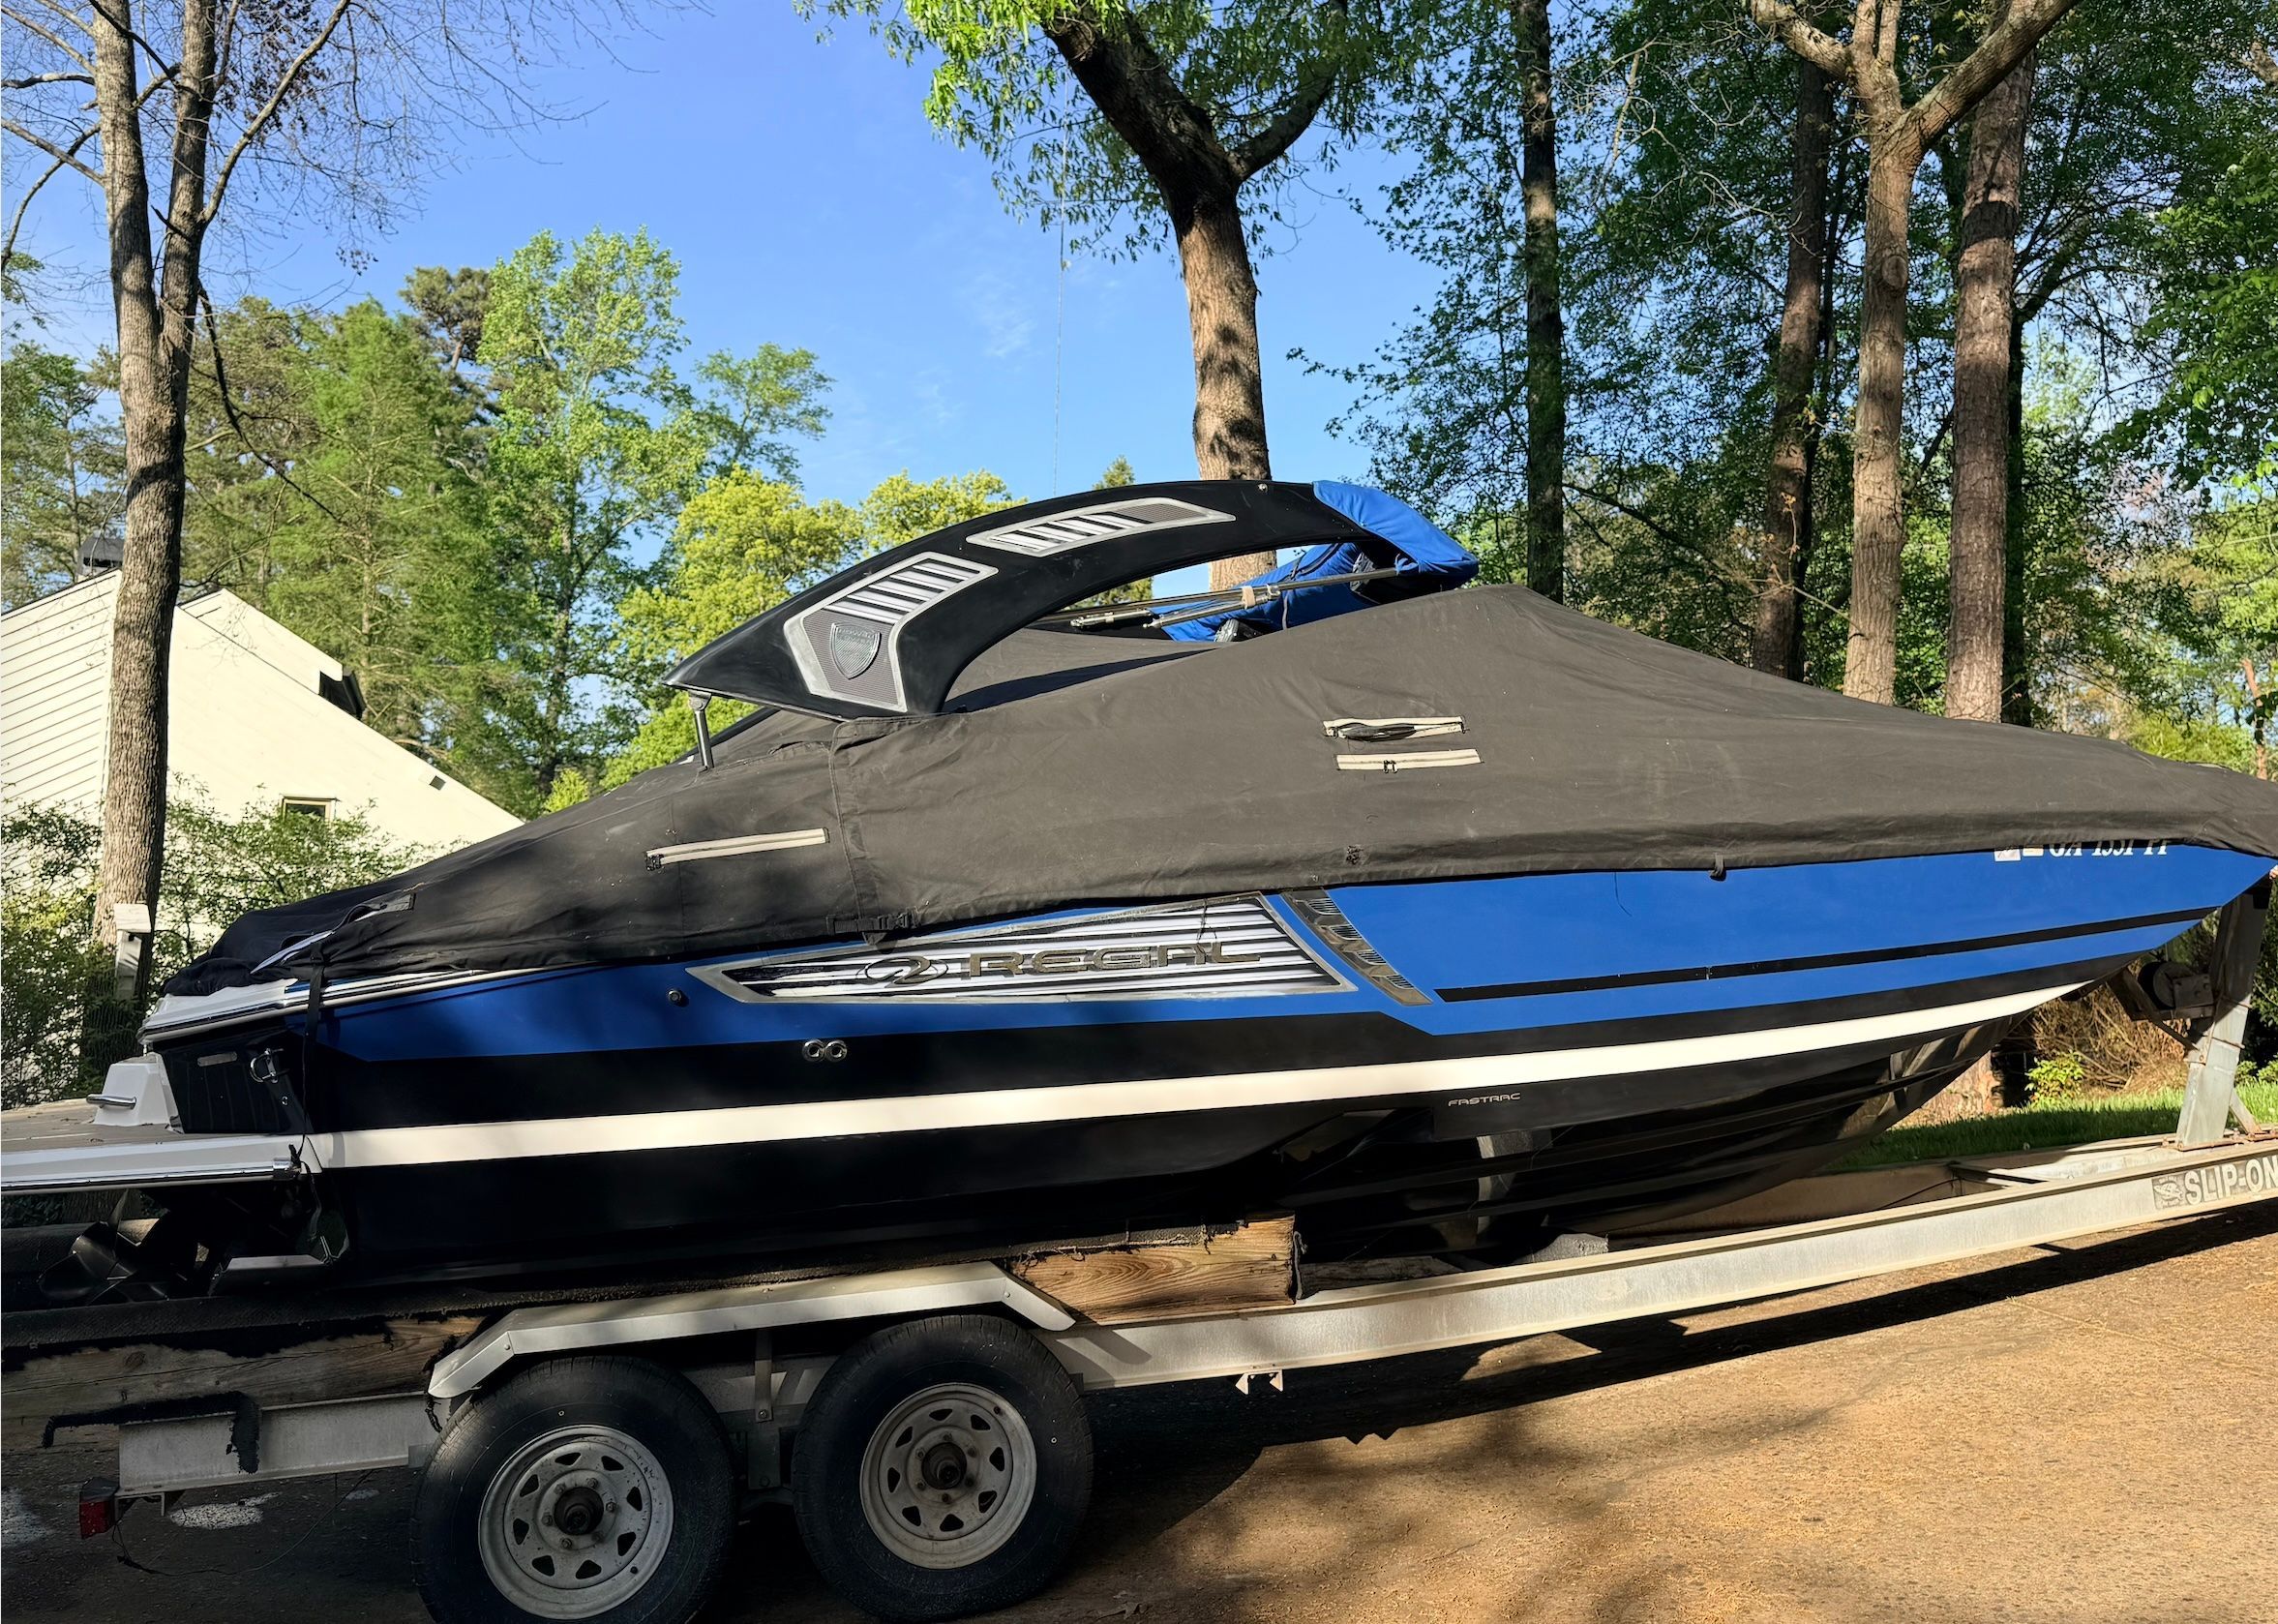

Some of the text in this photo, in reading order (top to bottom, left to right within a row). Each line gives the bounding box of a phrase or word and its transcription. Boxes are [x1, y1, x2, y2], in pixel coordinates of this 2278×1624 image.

[969, 942, 1261, 978] REGAL
[1448, 1093, 1521, 1107] FASTRAC
[2184, 1155, 2278, 1206] SLIP-ON
